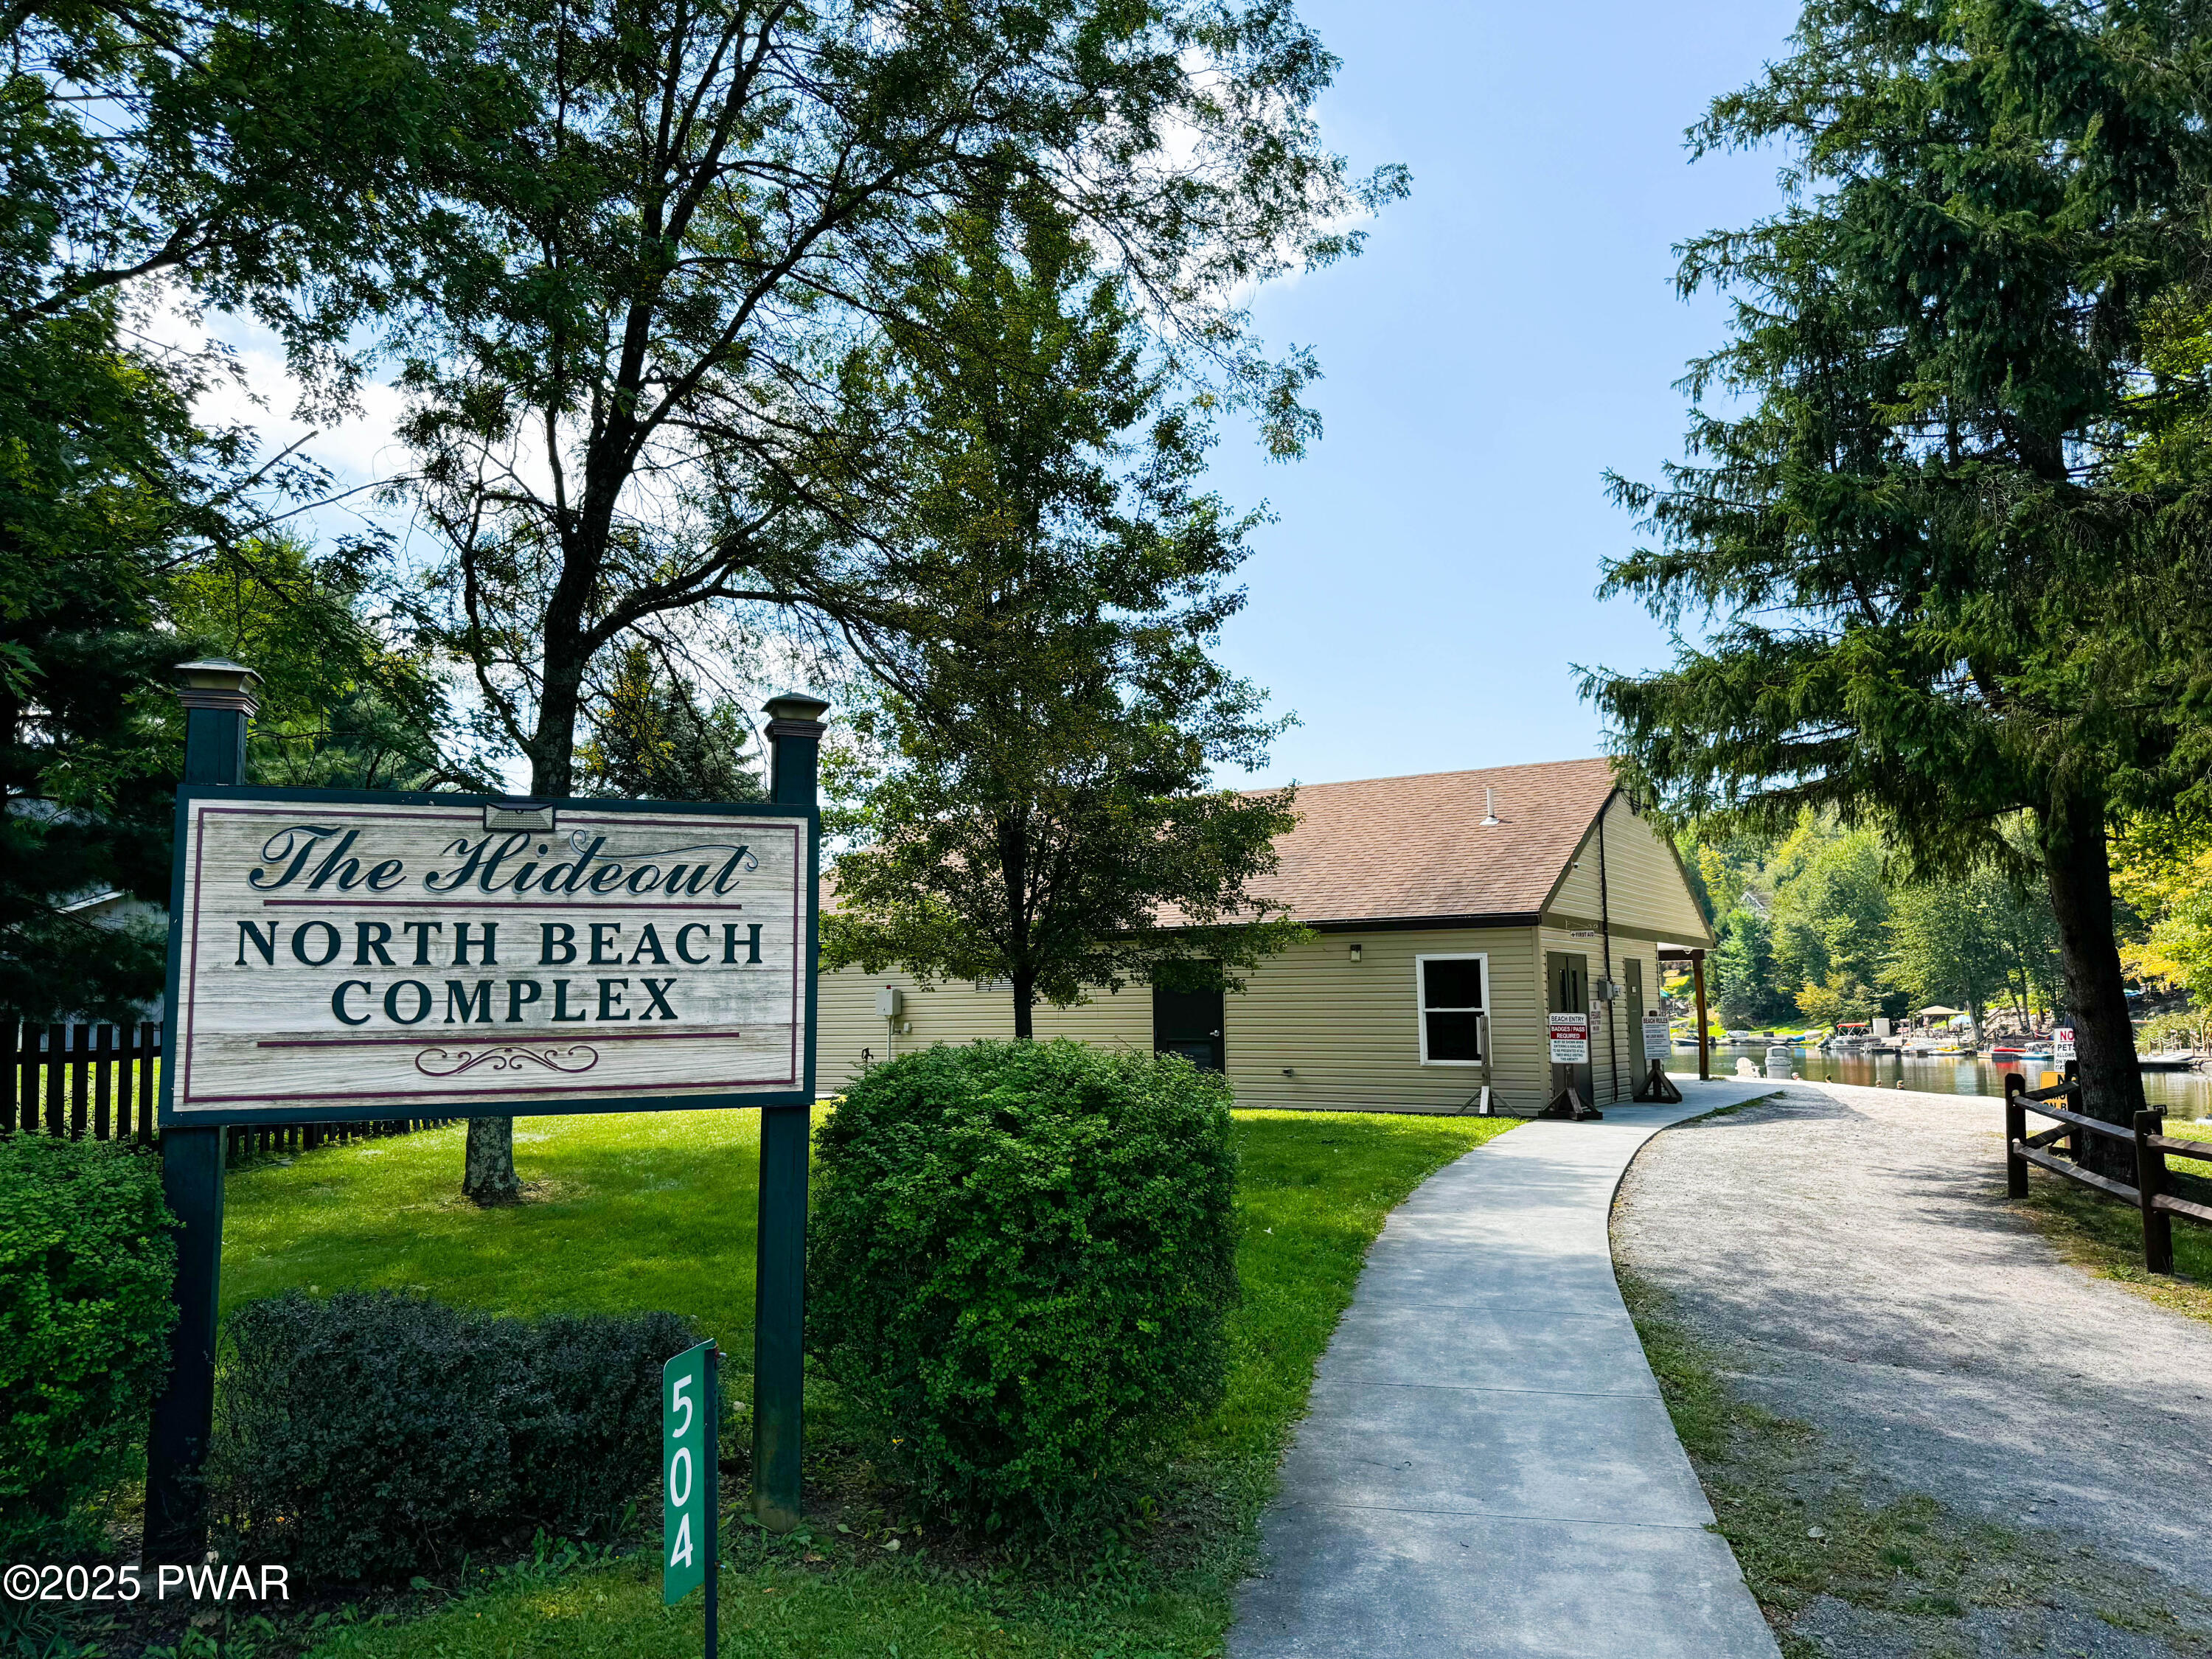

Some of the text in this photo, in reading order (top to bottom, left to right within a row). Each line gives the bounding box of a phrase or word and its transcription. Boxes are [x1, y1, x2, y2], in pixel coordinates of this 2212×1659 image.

[247, 824, 759, 897] The Hideout
[234, 919, 764, 967] NORTH BEACH
[331, 978, 679, 1026] COMPLEX
[2060, 1031, 2074, 1040] NO
[669, 1374, 693, 1568] 504
